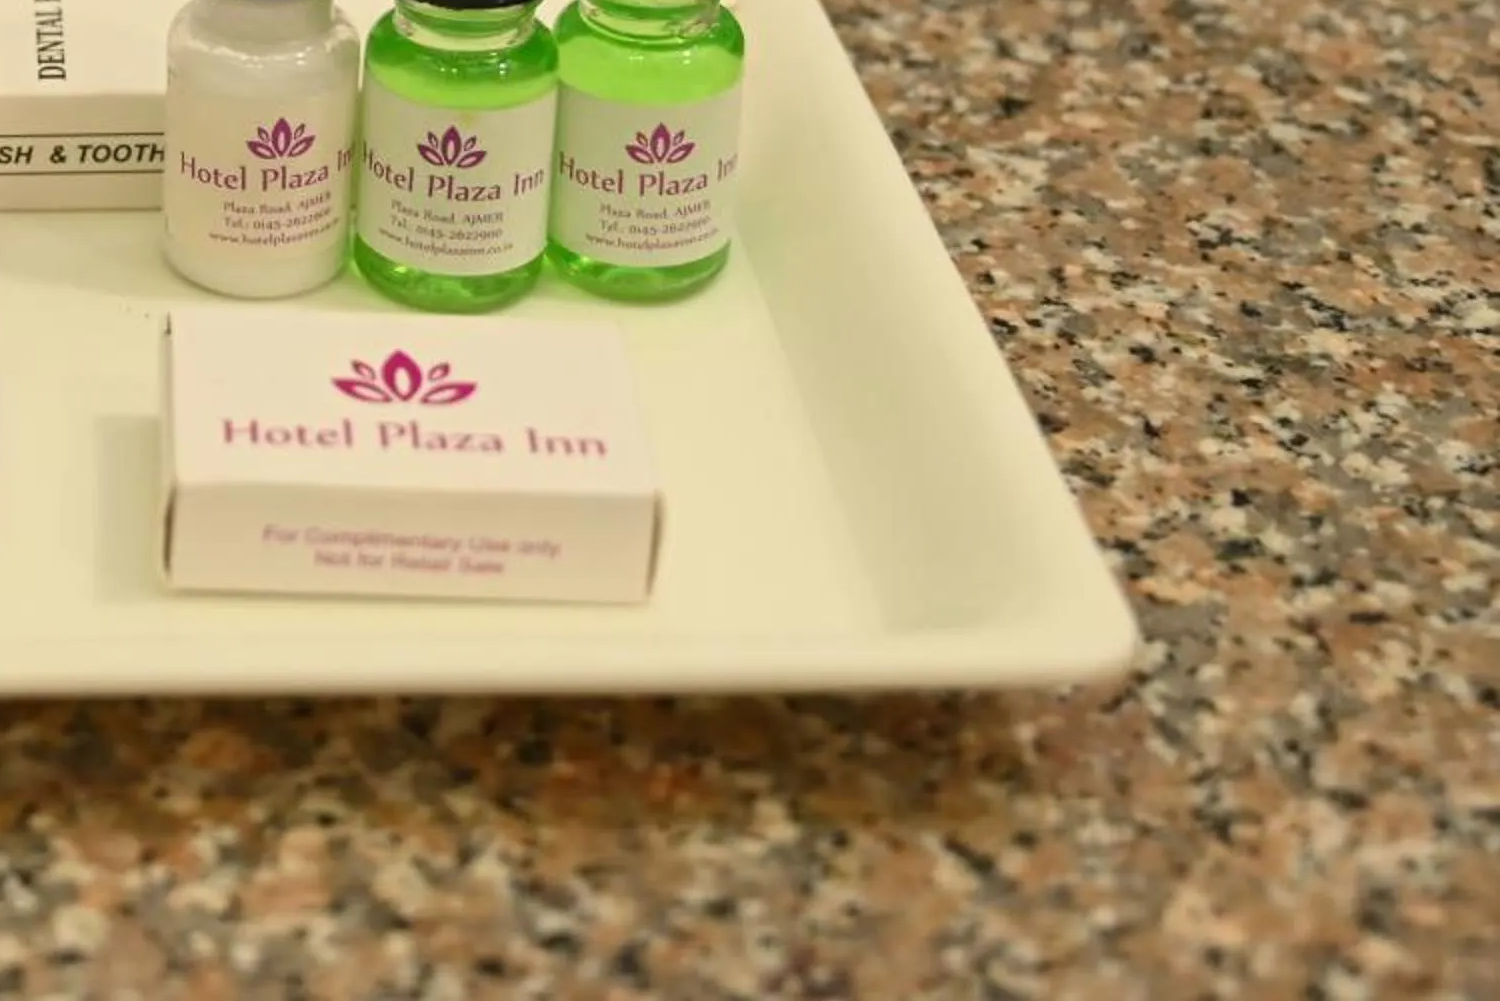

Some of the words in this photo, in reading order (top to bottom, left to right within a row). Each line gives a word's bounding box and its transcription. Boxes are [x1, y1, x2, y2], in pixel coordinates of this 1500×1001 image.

[34, 6, 66, 81] DENTAL
[49, 145, 67, 164] &
[76, 143, 165, 164] TOOTH
[180, 150, 247, 191] Hotel
[260, 164, 330, 191] Plaza
[362, 140, 415, 193] Hotel
[427, 173, 502, 202] Plaza
[513, 168, 545, 197] Inn
[559, 150, 625, 195] Hotel
[638, 170, 709, 198] Plaza
[221, 418, 354, 449] Hotel
[377, 419, 505, 455] Plaza
[526, 426, 609, 459] Inn
[261, 524, 299, 543] For
